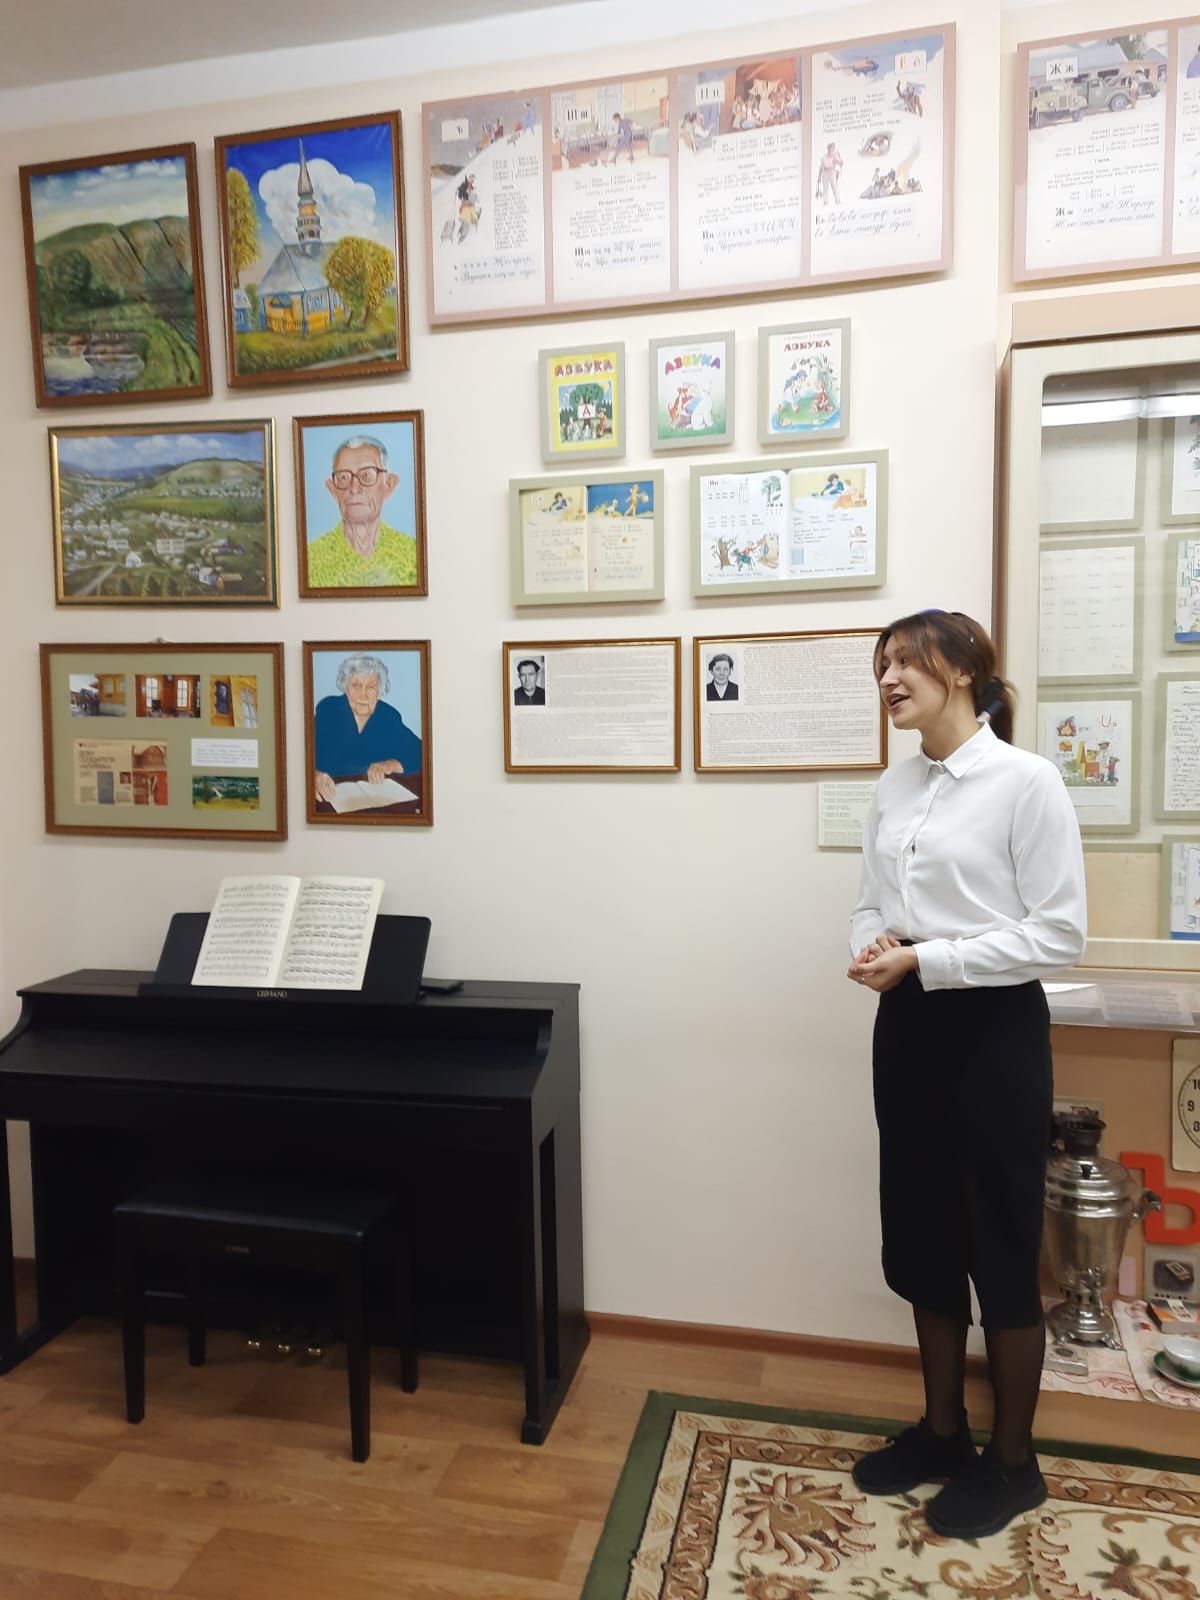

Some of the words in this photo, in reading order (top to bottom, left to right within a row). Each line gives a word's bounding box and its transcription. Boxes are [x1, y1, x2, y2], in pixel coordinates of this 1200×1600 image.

[1050, 63, 1061, 75] Ж
[783, 340, 831, 352] АЗБУКА
[554, 359, 613, 377] АЗБУКА
[664, 353, 721, 376] АЗБУКА
[582, 405, 591, 417] А
[1187, 1100, 1195, 1112] 9
